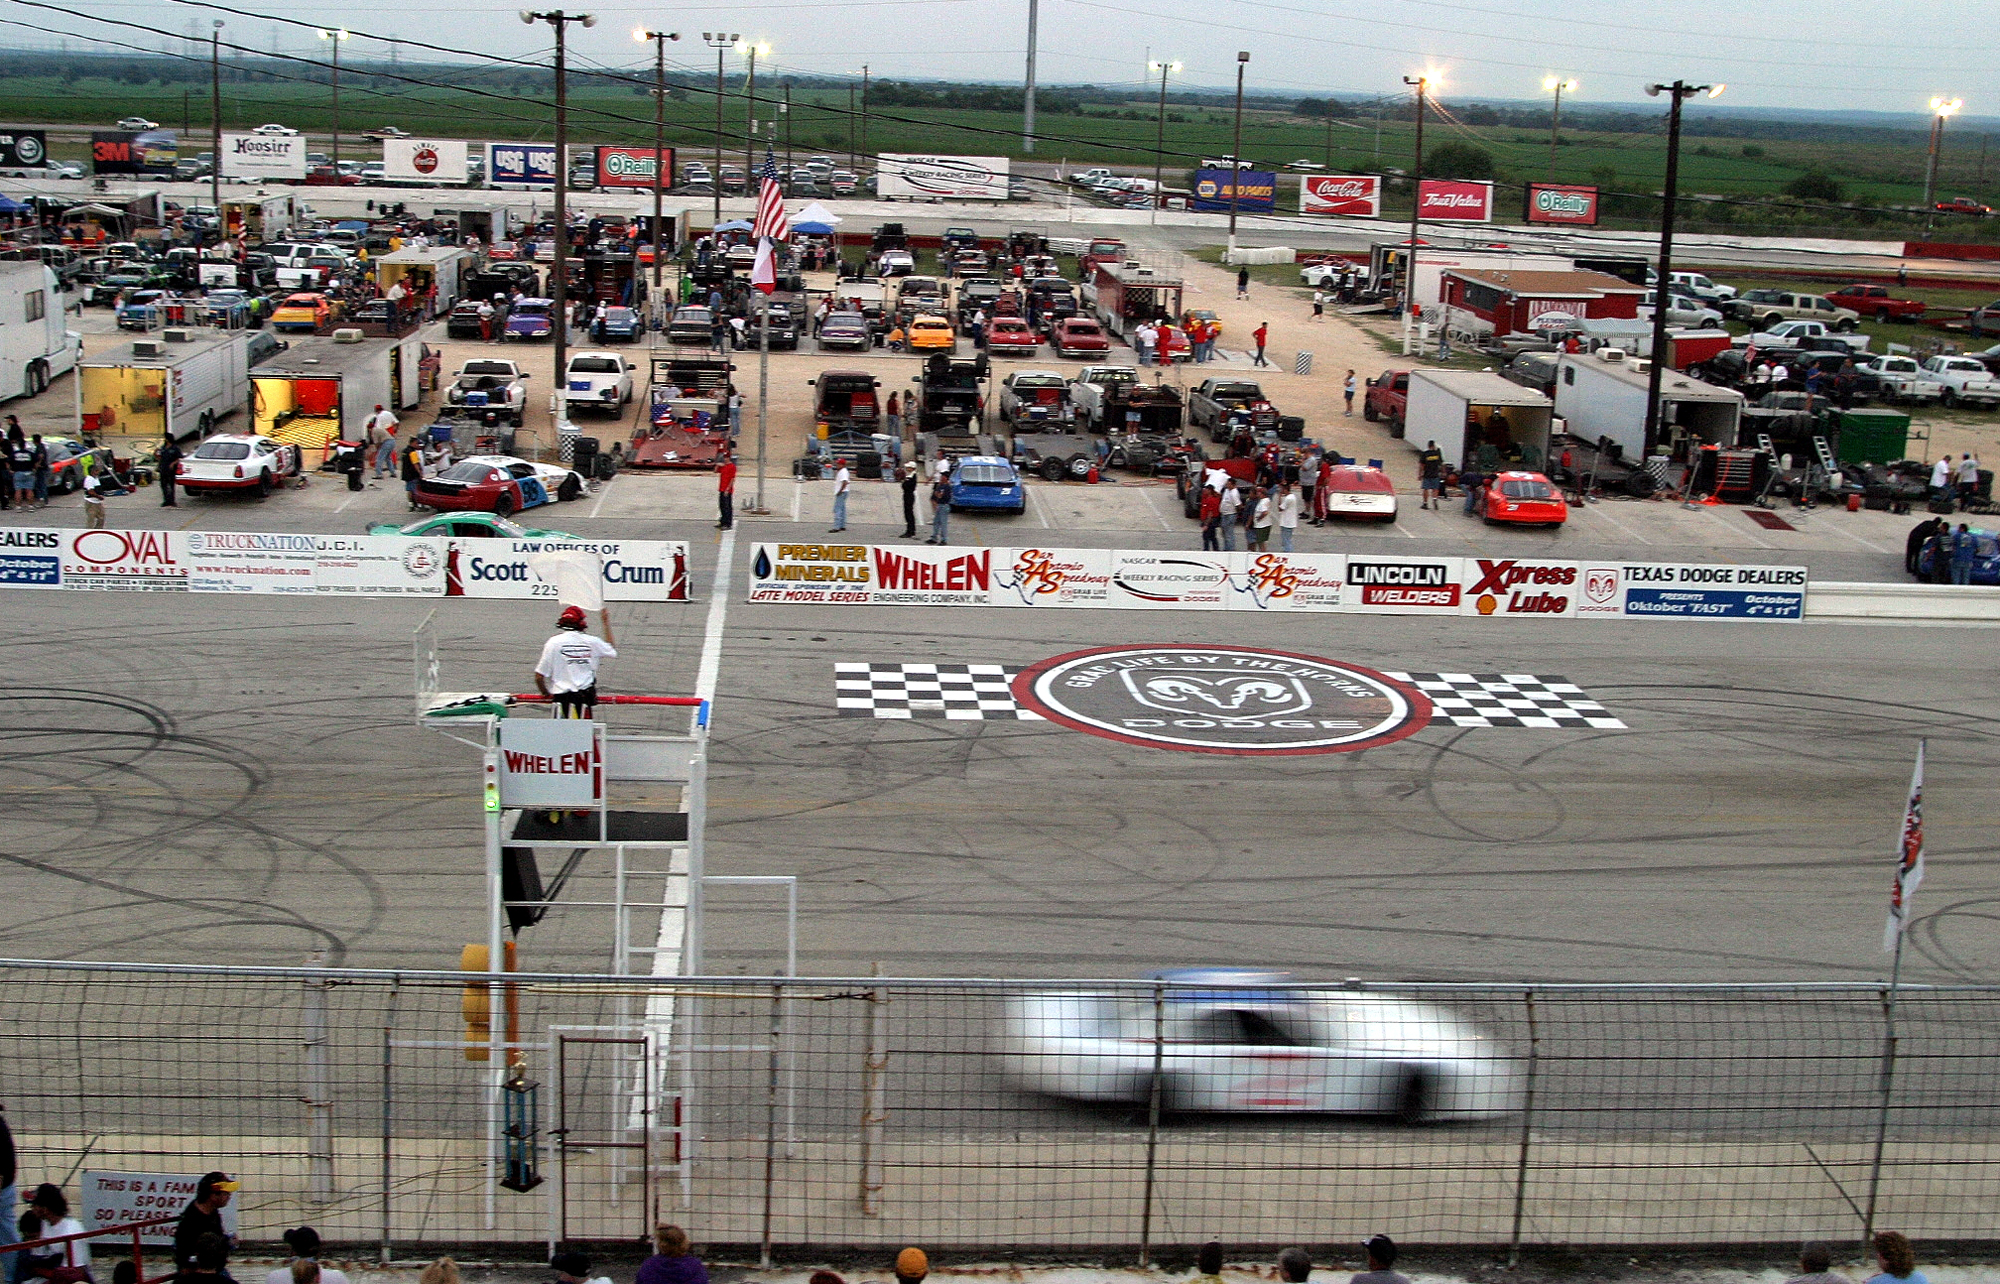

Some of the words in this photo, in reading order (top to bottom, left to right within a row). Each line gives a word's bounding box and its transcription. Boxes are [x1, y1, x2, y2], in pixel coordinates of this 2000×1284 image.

[93, 141, 130, 161] 3M
[233, 138, 291, 153] Hoosier
[496, 151, 525, 173] USG
[528, 152, 556, 174] USG
[1221, 185, 1246, 195] AUO
[73, 531, 176, 564] OVAL
[205, 534, 316, 550] TRUCKNATION
[316, 541, 364, 550] J.C.I.
[513, 543, 541, 552] LAW
[602, 545, 620, 554] OF
[777, 544, 867, 561] PREMIER
[64, 565, 189, 575] COMPONENTS
[196, 566, 311, 576] www.trucknation.com
[470, 558, 528, 582] Scott
[601, 560, 664, 584] Crum
[775, 565, 870, 582] MINERALS
[873, 548, 990, 591] WHELEN
[1352, 566, 1443, 585] LINCOLN
[1623, 567, 1675, 582] TEXAS
[1680, 568, 1733, 583] DODGE
[1738, 570, 1805, 585] DEALERS
[1465, 560, 1577, 595] Xpress
[750, 590, 782, 600] LATE
[783, 591, 825, 601] MODEL
[828, 592, 870, 602] SERIES
[873, 592, 929, 602] ENGINEERING
[1370, 590, 1452, 604] WELDERS
[1506, 591, 1568, 613] Lube
[1659, 592, 1705, 601] PRESENTS
[1743, 595, 1799, 605] October
[1628, 601, 1687, 612] Oktober
[1111, 656, 1174, 670] LIFE
[1180, 655, 1221, 665] BY
[1231, 657, 1289, 672] THE
[1292, 666, 1375, 699] HORNS
[1121, 718, 1363, 730] DODGE
[504, 750, 591, 774] WHELEN
[97, 1178, 126, 1191] THIS
[129, 1180, 143, 1192] IS
[147, 1181, 156, 1193] A
[163, 1181, 195, 1193] FAM
[135, 1195, 187, 1208] SPORT
[94, 1208, 116, 1220] SO
[141, 1225, 178, 1237] LANG
